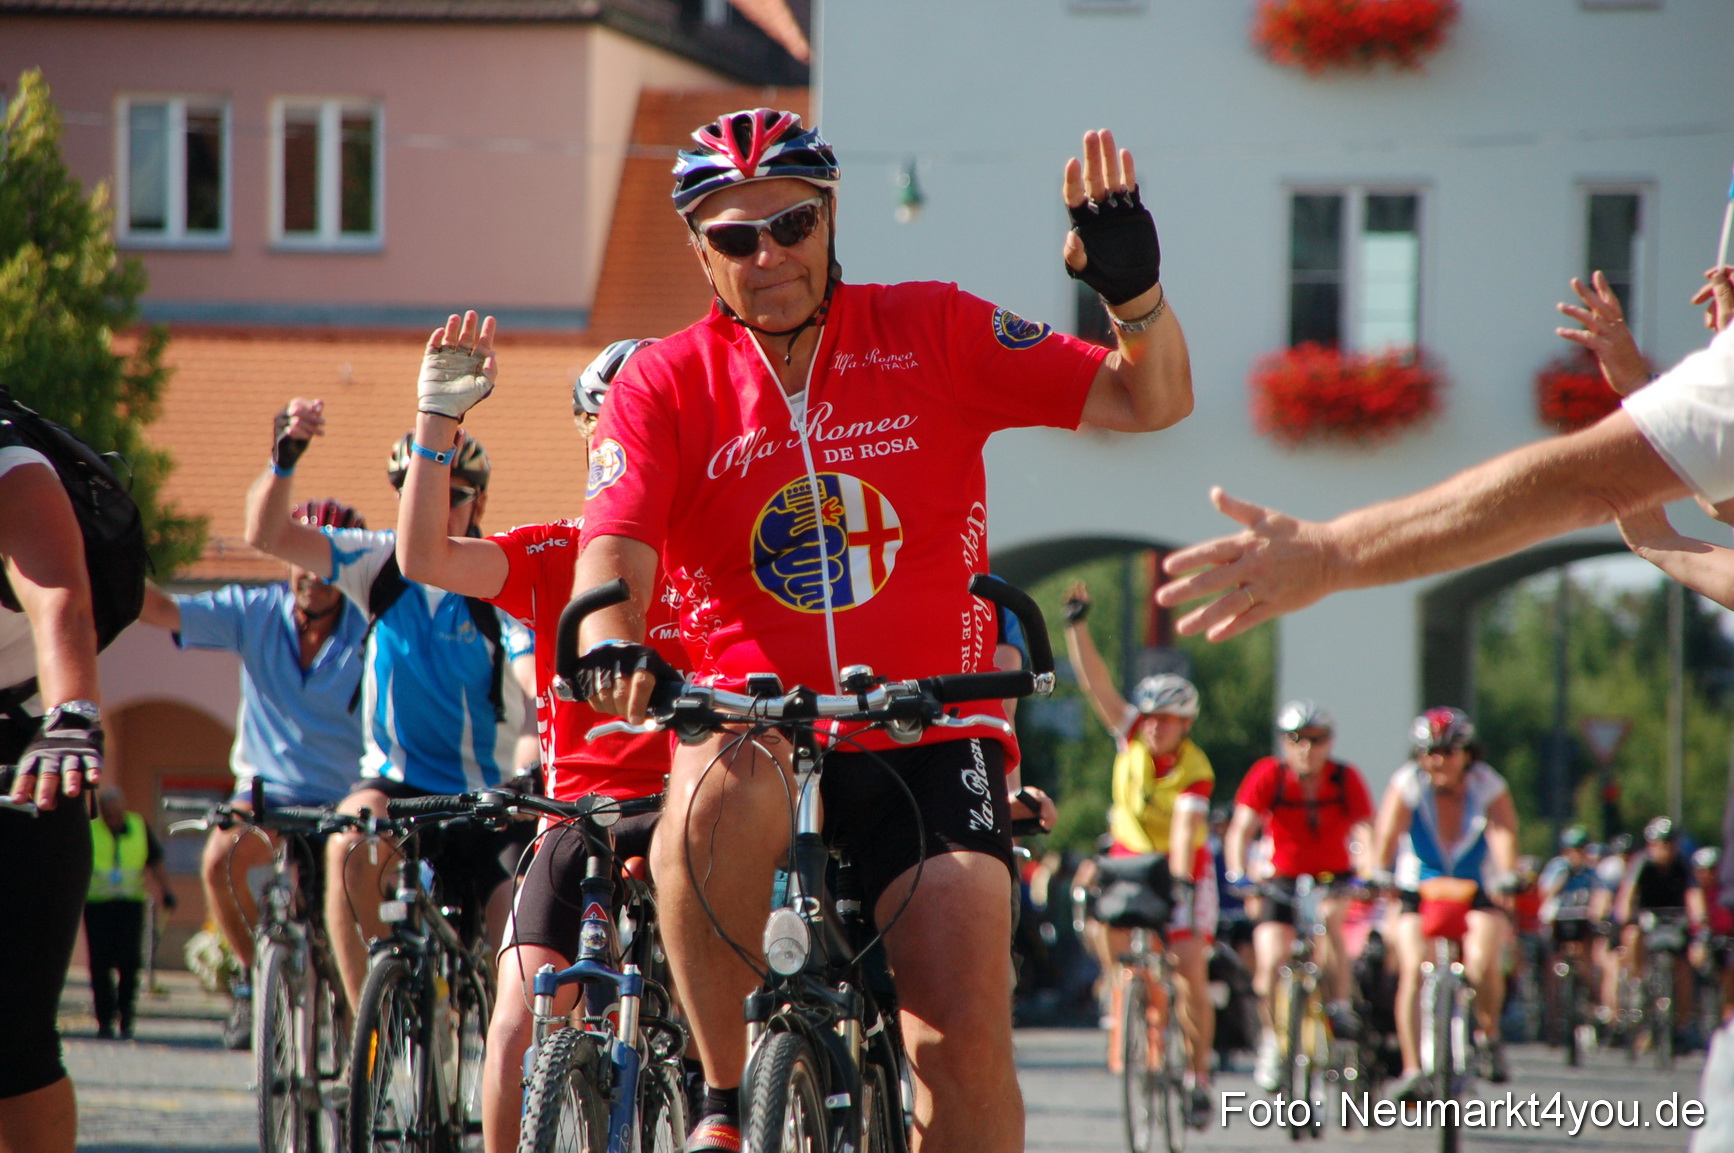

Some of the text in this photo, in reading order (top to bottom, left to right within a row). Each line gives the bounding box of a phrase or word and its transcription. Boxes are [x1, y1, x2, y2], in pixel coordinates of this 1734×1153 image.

[829, 348, 914, 376] Alfa Romeo
[880, 360, 919, 372] ITALIA
[707, 401, 919, 480] Alfa Romeo
[823, 436, 920, 464] DE ROSA
[961, 611, 972, 674] DE RO
